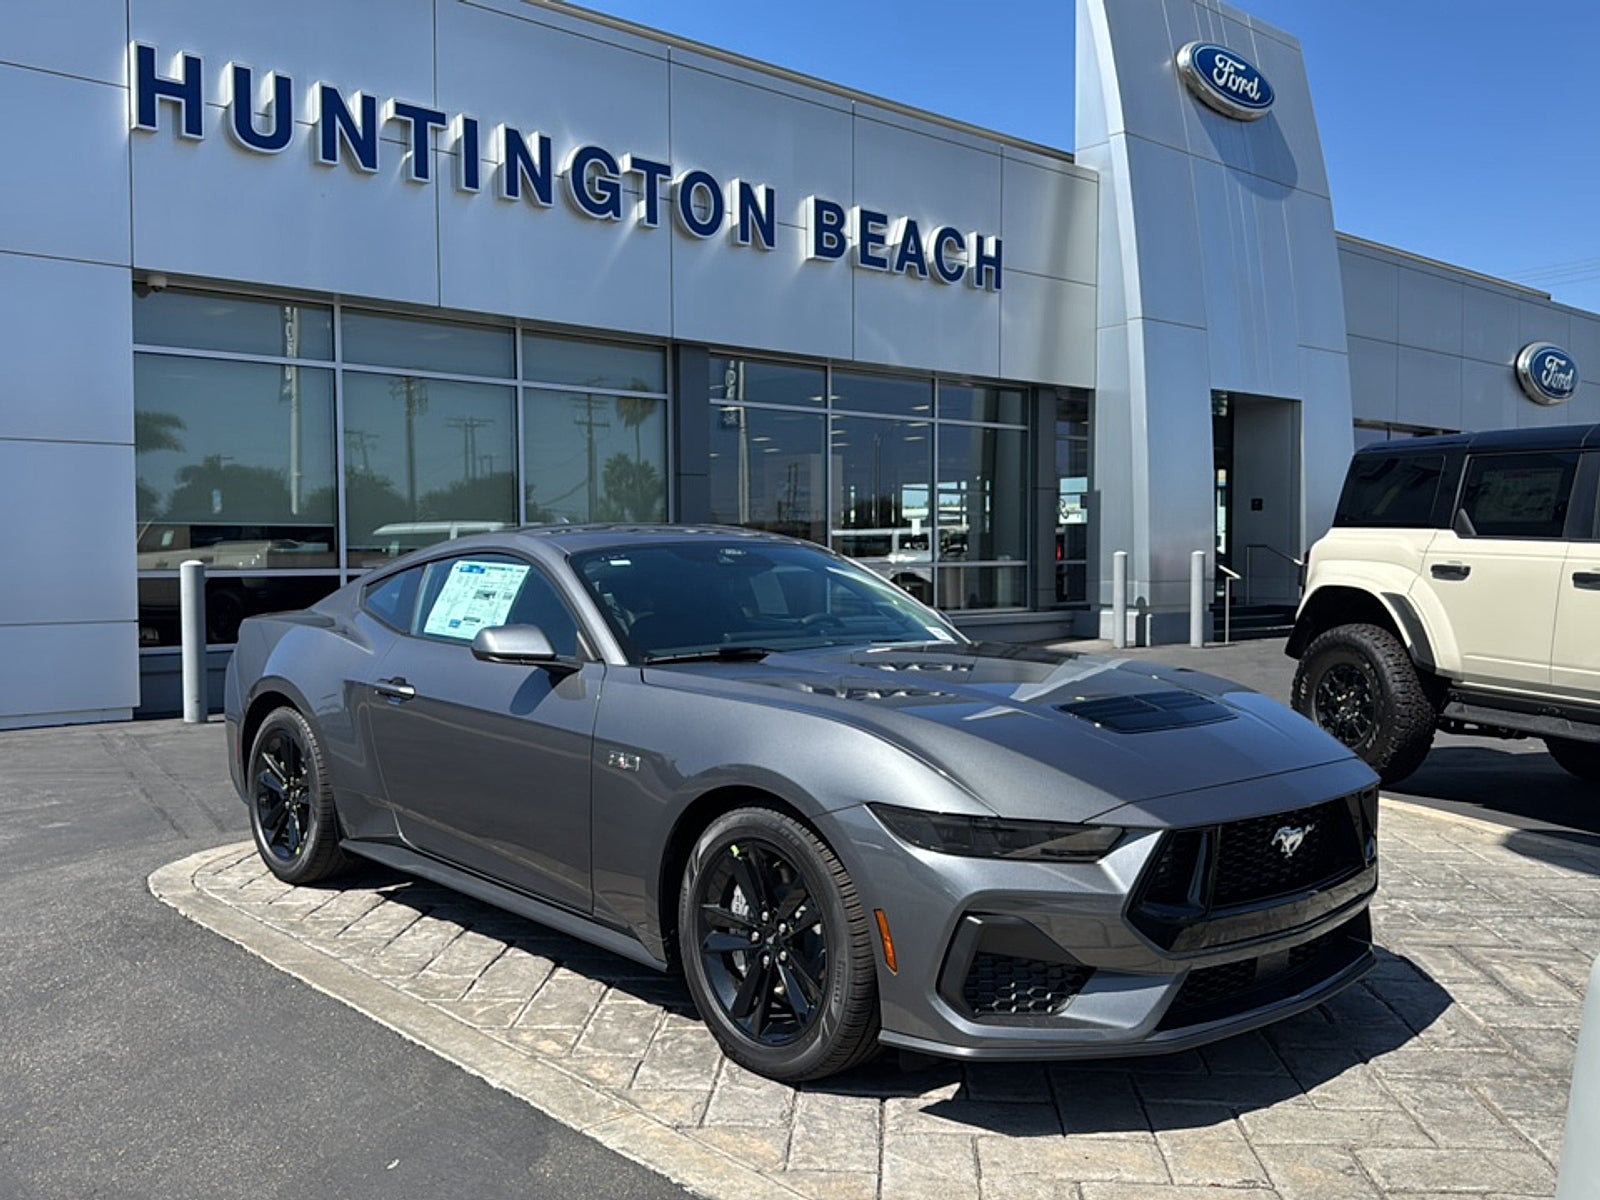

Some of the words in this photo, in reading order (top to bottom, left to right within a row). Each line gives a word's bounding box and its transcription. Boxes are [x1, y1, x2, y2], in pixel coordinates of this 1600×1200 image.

[1213, 53, 1261, 101] Ford
[131, 41, 776, 249] HUNTINGTON
[808, 196, 1002, 291] BEACH
[1541, 355, 1574, 390] Ford
